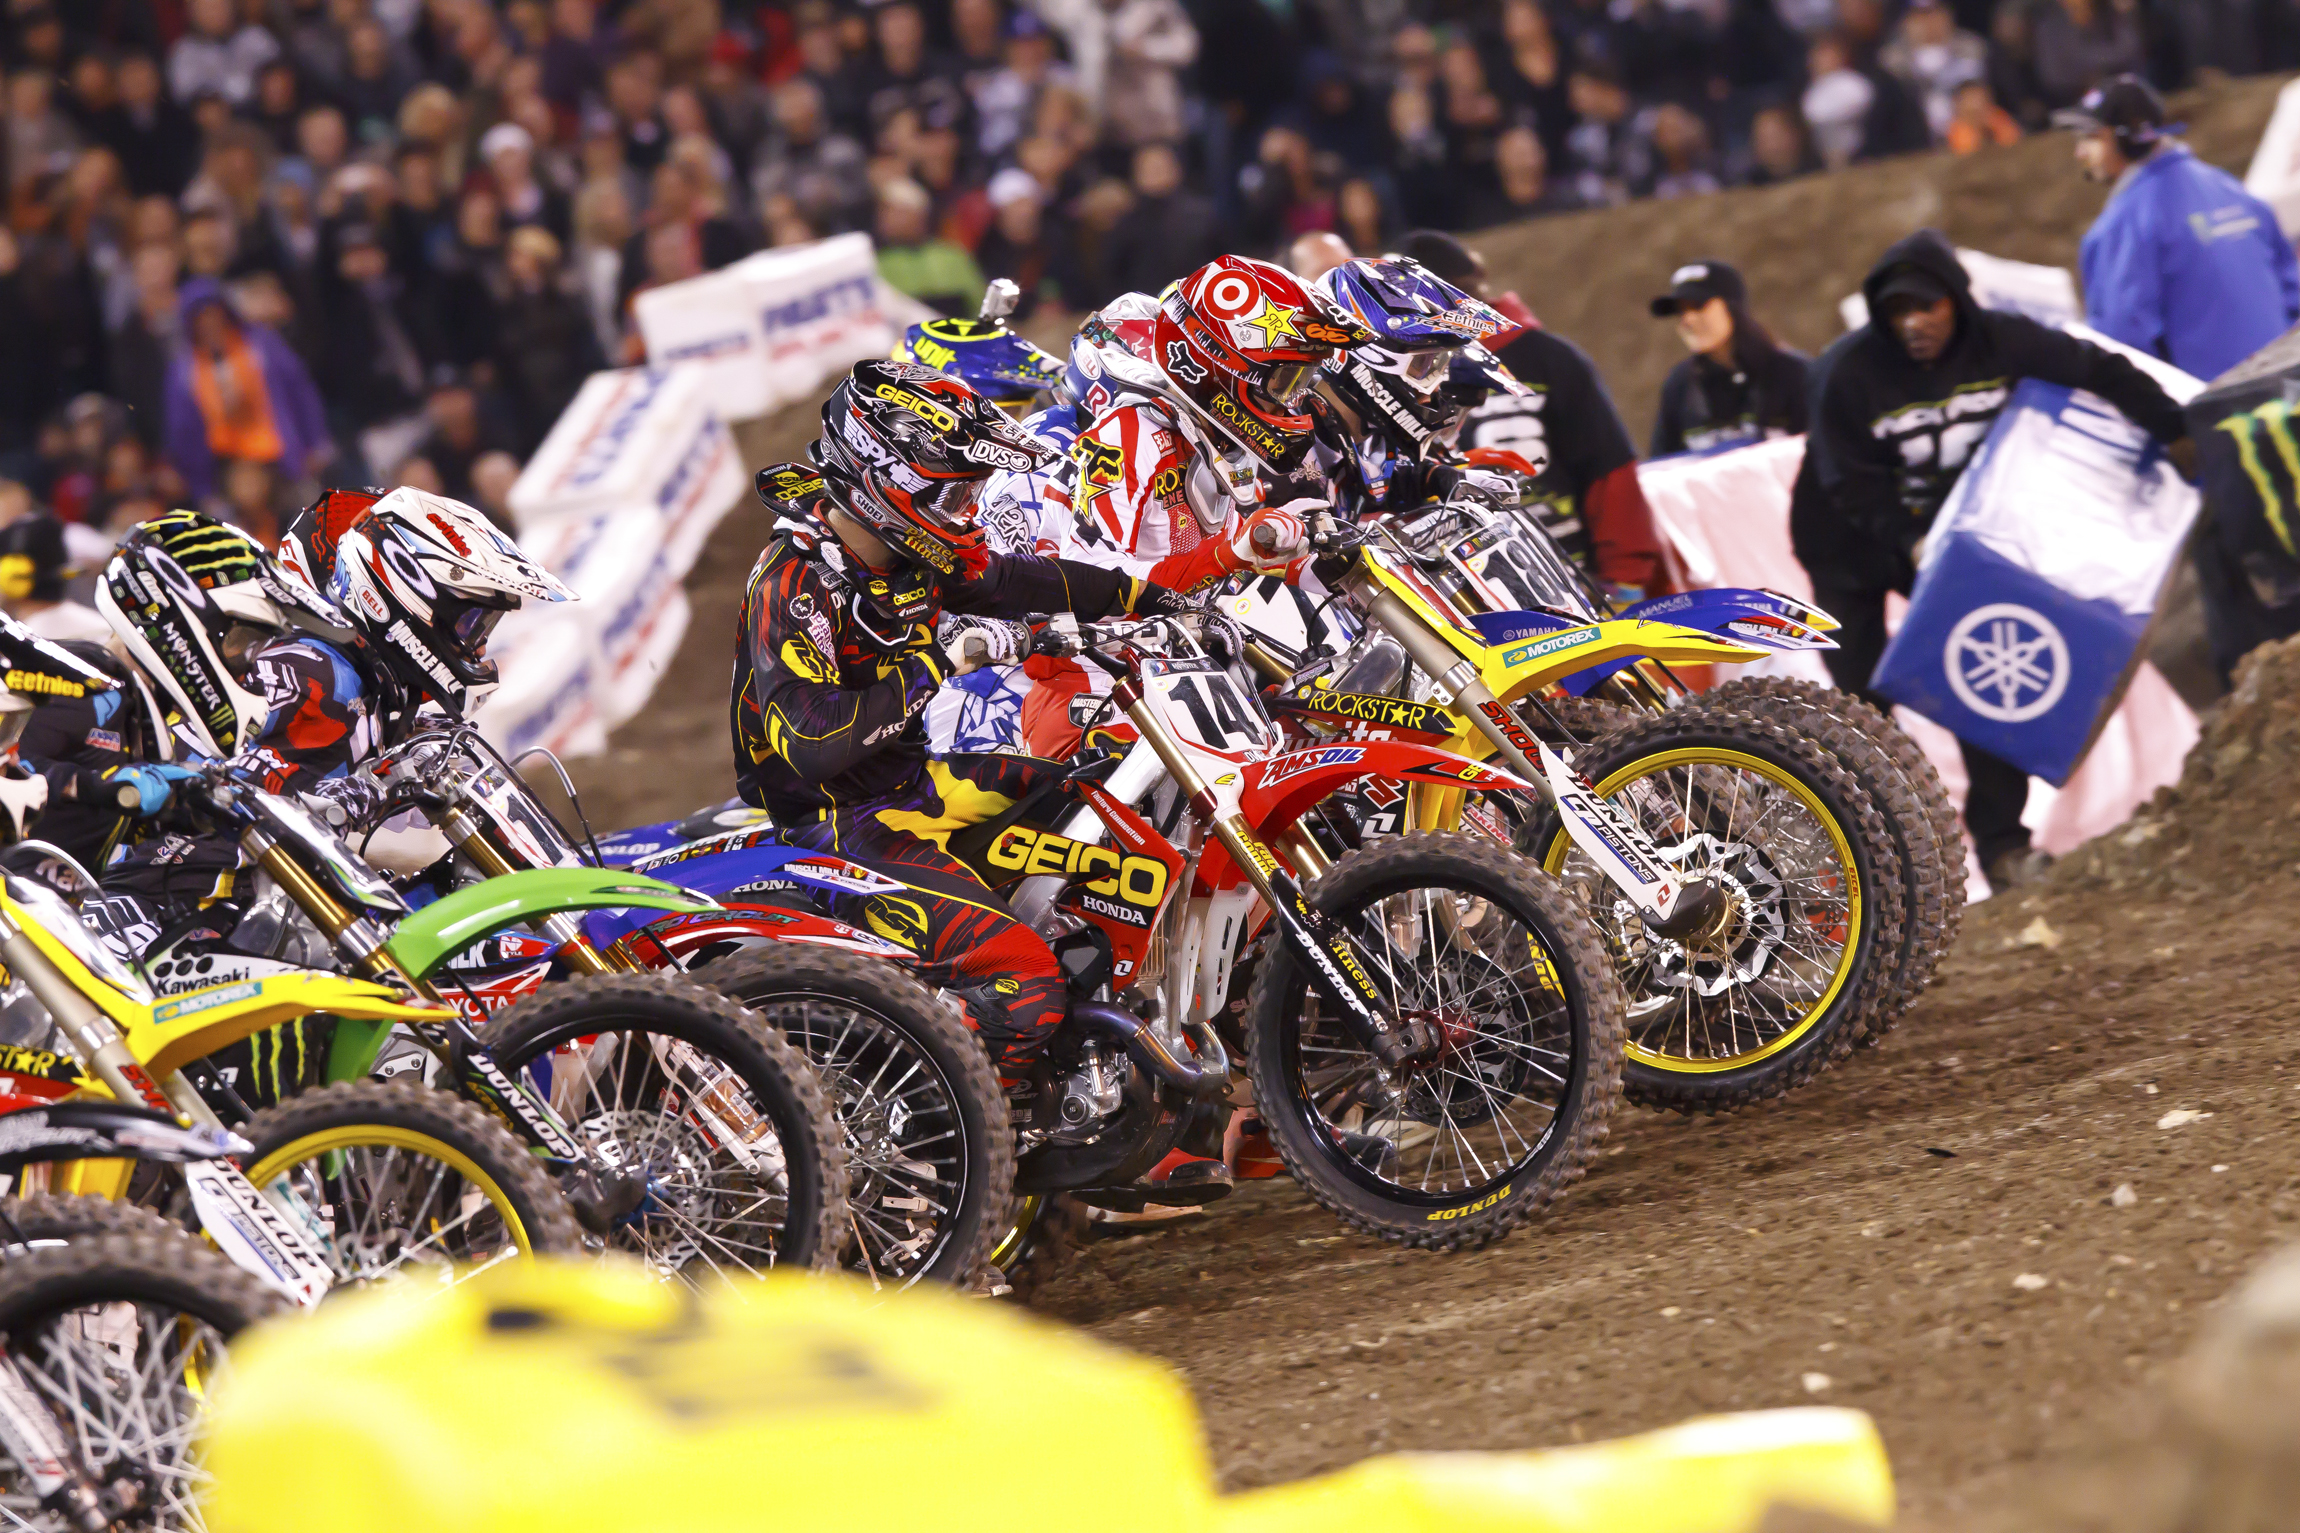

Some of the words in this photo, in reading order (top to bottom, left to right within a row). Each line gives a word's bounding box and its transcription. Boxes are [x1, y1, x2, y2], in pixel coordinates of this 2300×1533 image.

[913, 335, 958, 370] unit
[875, 382, 956, 432] GEICO
[1350, 362, 1401, 421] MUSCLE
[1392, 411, 1432, 442] MILK
[852, 431, 898, 468] SPY
[974, 440, 1013, 468] DVS
[1244, 436, 1270, 461] DRINK
[1155, 463, 1189, 498] ROC
[855, 494, 885, 522] SHOEI
[904, 525, 960, 563] planet
[904, 535, 955, 576] fitness
[361, 588, 384, 618] BELL
[893, 586, 927, 606] GEICO
[905, 603, 929, 616] HONDA
[1515, 626, 1558, 640] YAMAHA
[1527, 628, 1596, 658] MOTOREX
[163, 620, 222, 711] MONSTER
[387, 618, 439, 673] MUSCLE
[428, 655, 466, 696] MILK
[881, 688, 934, 739] HONDA
[1167, 674, 1266, 750] 14
[1477, 700, 1552, 782] SHOW
[1256, 747, 1368, 790] AMSOIL
[1090, 789, 1113, 814] Factory
[1108, 808, 1146, 846] Connection
[1566, 773, 1673, 873] DUNLOP
[784, 863, 819, 875] MUSCLE
[818, 865, 841, 876] MILK
[986, 824, 1168, 908] GEICO
[1597, 827, 1656, 882] PISTONS
[1849, 866, 1859, 900] EXCEL
[689, 908, 804, 927] CIRCUIT
[1082, 894, 1148, 926] HONDA
[157, 966, 250, 996] Kawasaki
[1295, 930, 1373, 1018] DUNLOP
[178, 983, 258, 1014] MOTOREX
[467, 1053, 578, 1159] DUNLOP
[1426, 1183, 1513, 1222] DUNLOP
